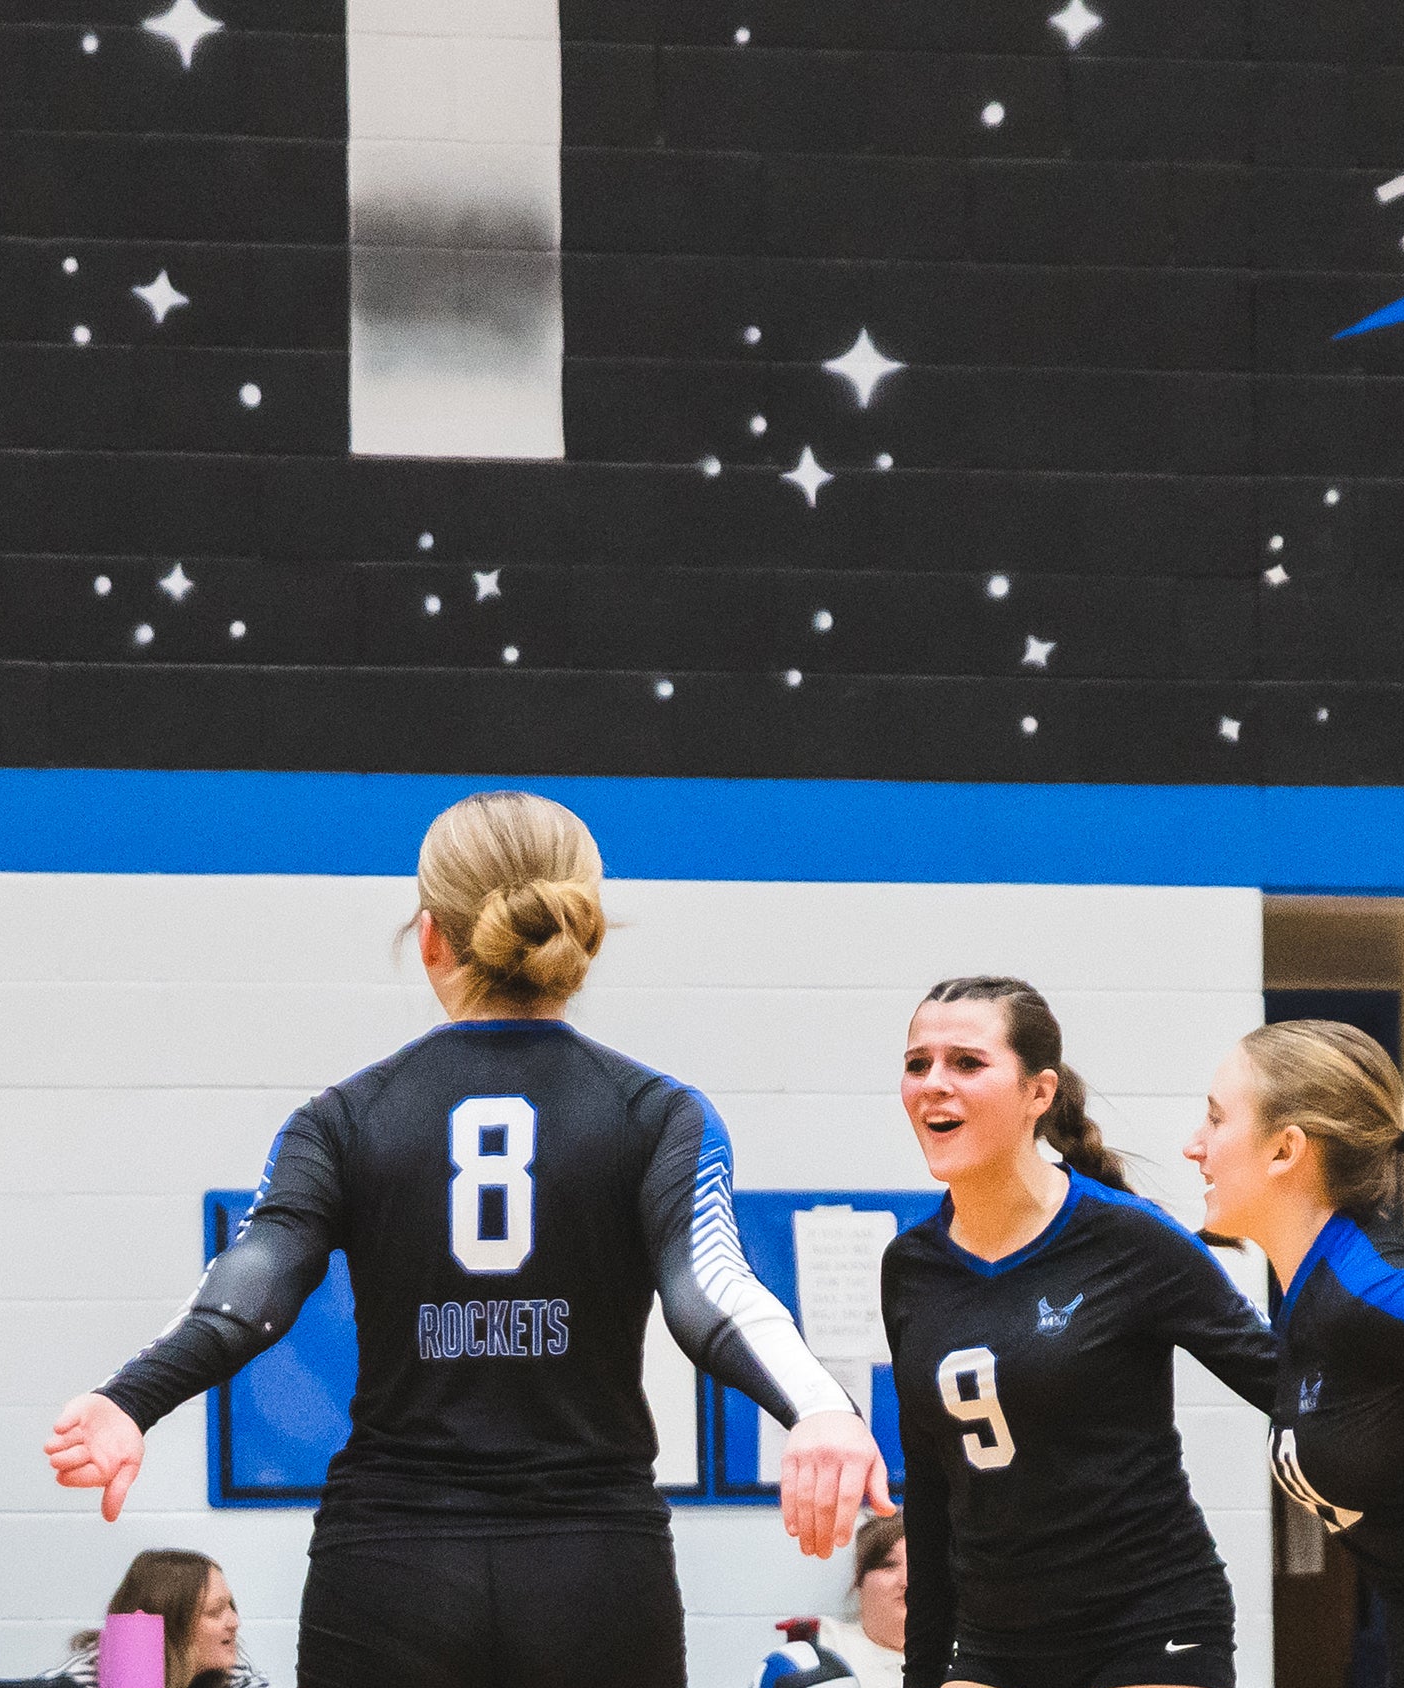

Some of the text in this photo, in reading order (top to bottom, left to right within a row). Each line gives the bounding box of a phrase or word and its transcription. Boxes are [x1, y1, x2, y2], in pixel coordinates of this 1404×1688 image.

[448, 1094, 538, 1276] 8
[418, 1298, 570, 1360] ROCKETS
[936, 1345, 1016, 1471] 9
